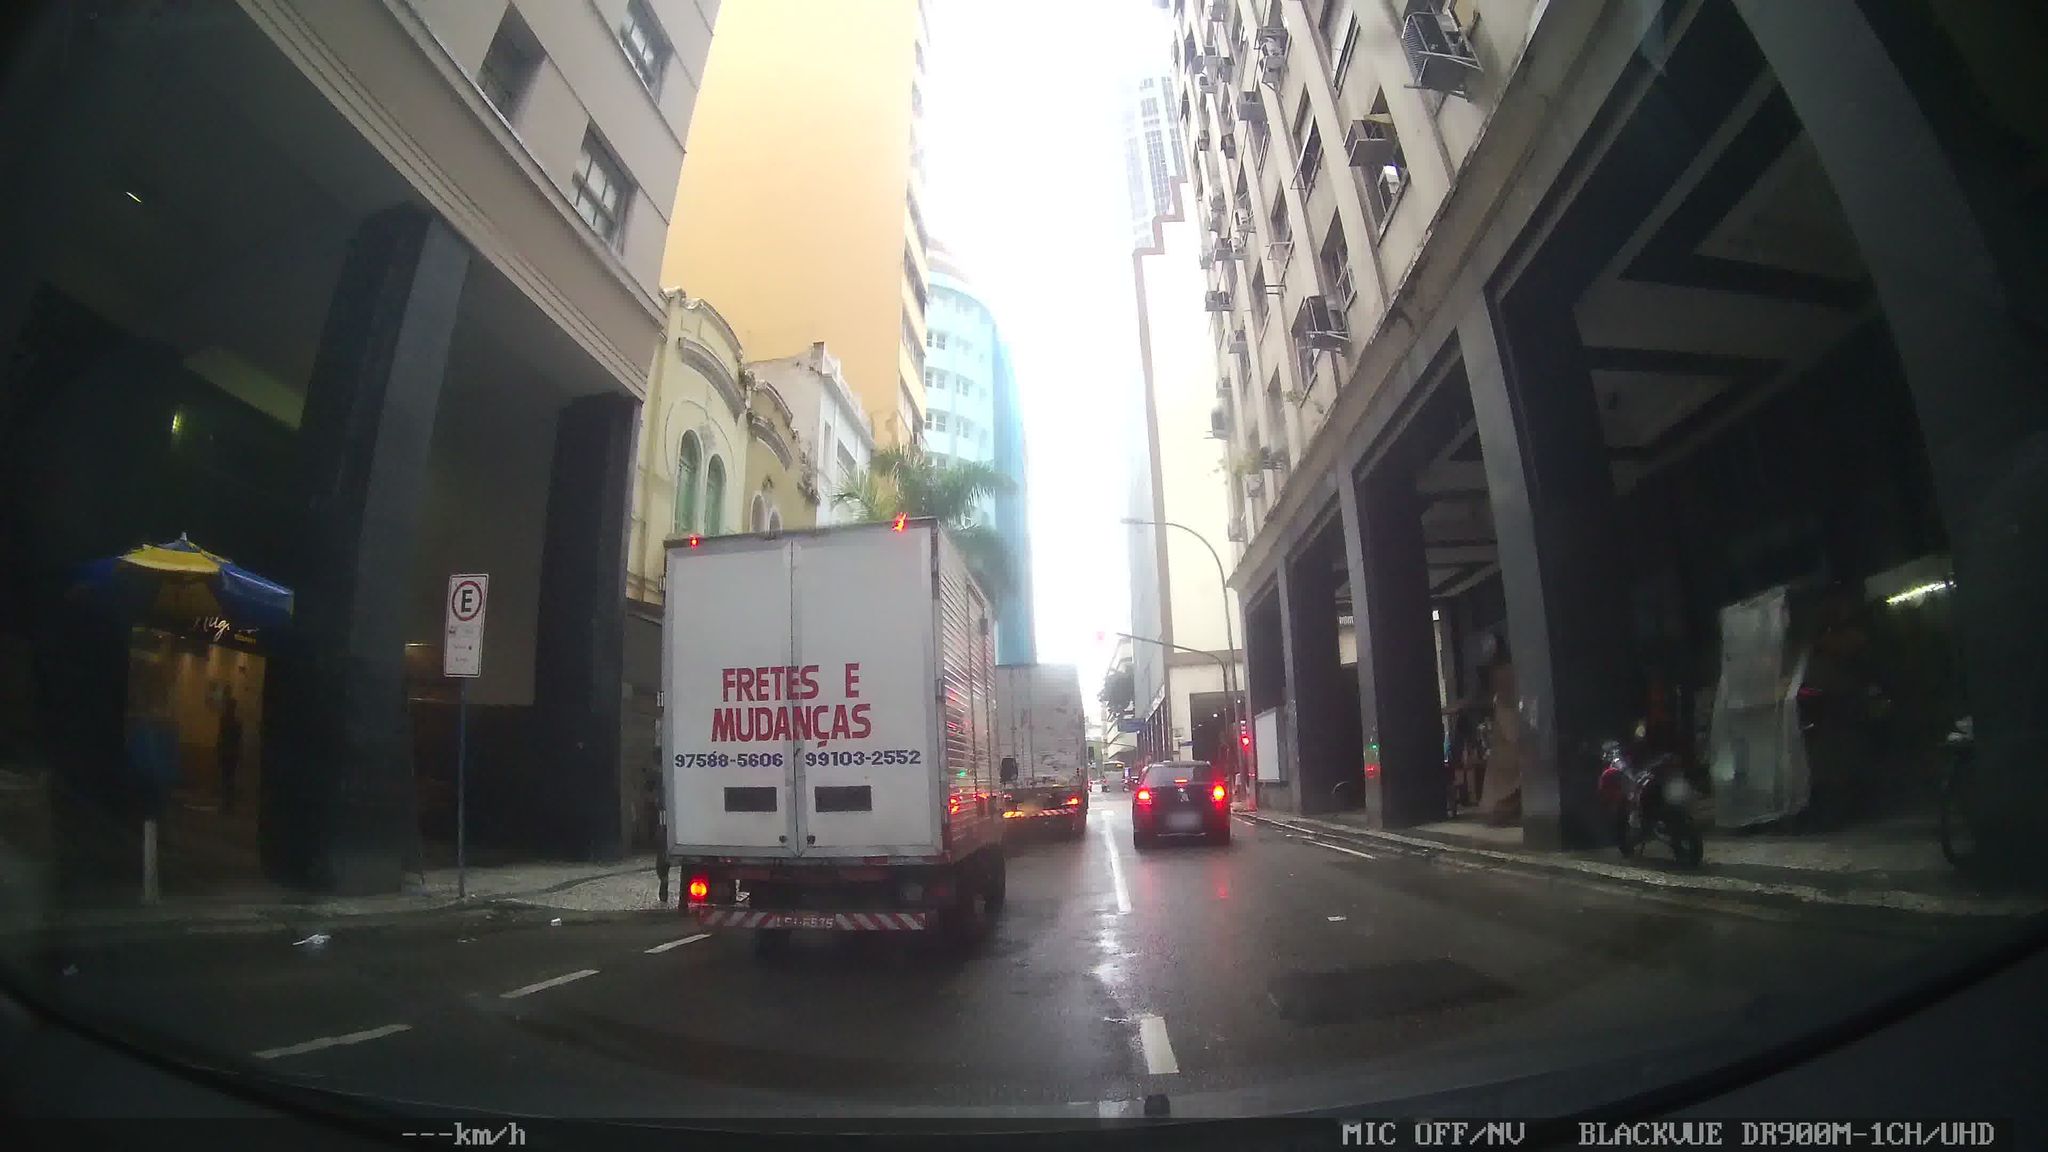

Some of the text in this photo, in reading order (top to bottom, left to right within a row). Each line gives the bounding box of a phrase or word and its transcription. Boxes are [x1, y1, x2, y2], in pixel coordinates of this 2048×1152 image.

[461, 589, 473, 612] E
[722, 663, 859, 702] FRETES E
[711, 704, 871, 748] MUDANÇAS
[674, 750, 921, 768] 97588-5606 99103-2552
